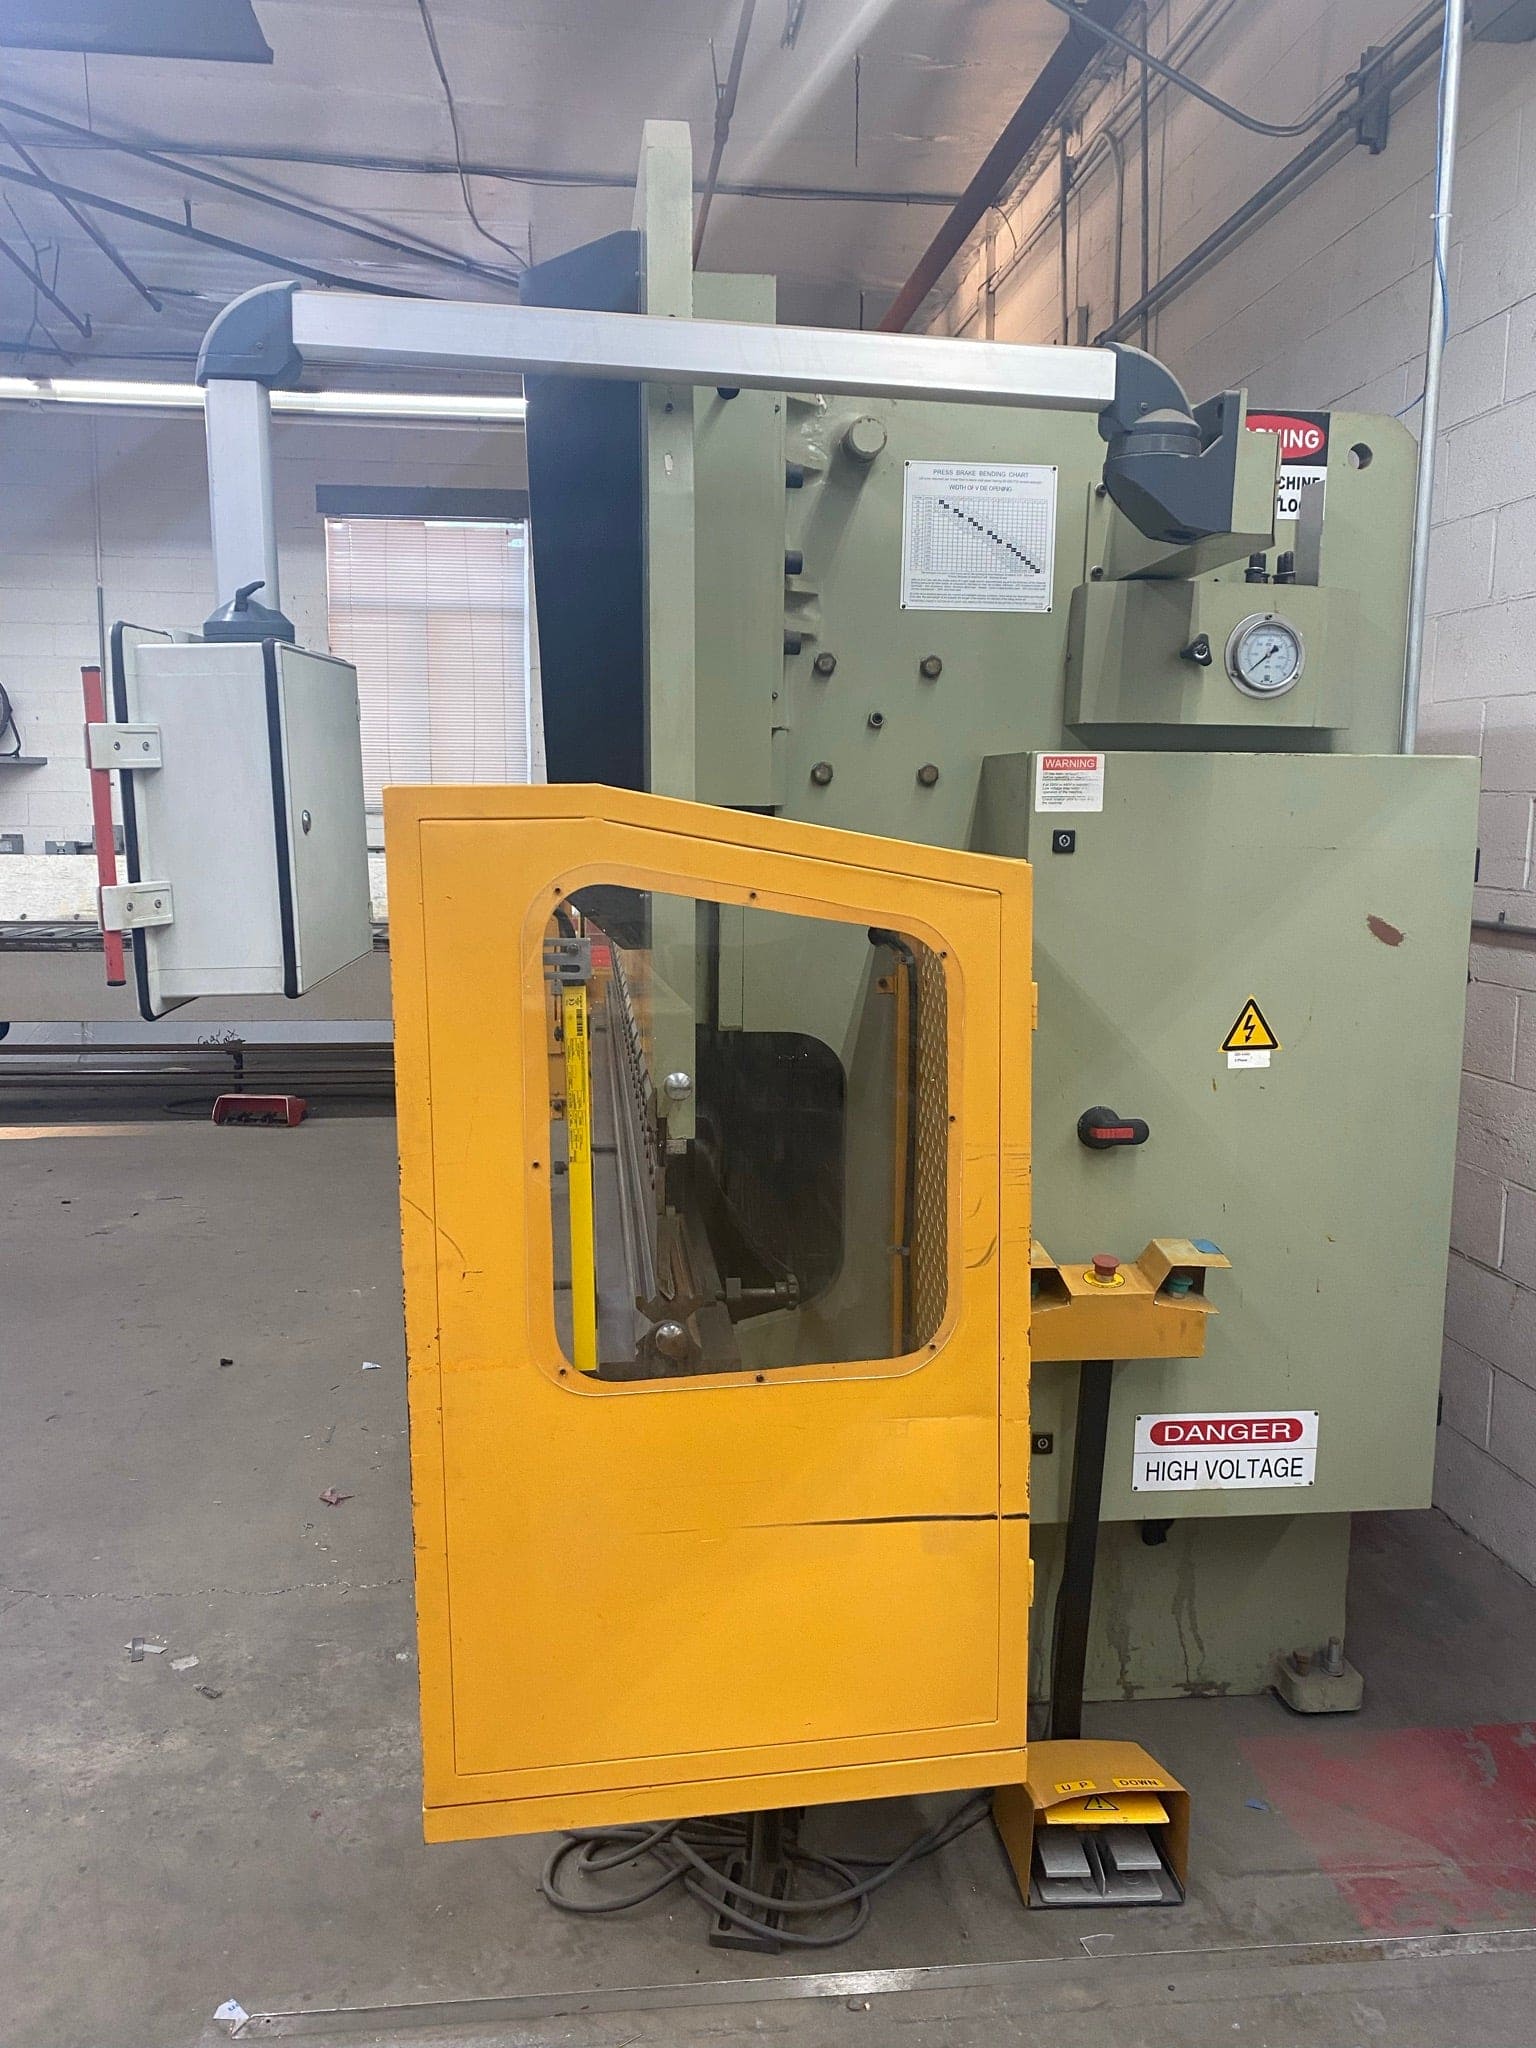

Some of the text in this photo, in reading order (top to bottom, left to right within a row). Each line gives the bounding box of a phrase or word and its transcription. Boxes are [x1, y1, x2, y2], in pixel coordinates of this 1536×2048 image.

[1279, 498, 1301, 512] LO
[1045, 759, 1096, 768] WARNING
[1164, 1422, 1291, 1442] DANGER
[1146, 1457, 1304, 1482] HIGH VOLTAGE
[1119, 1778, 1158, 1787] DOWN
